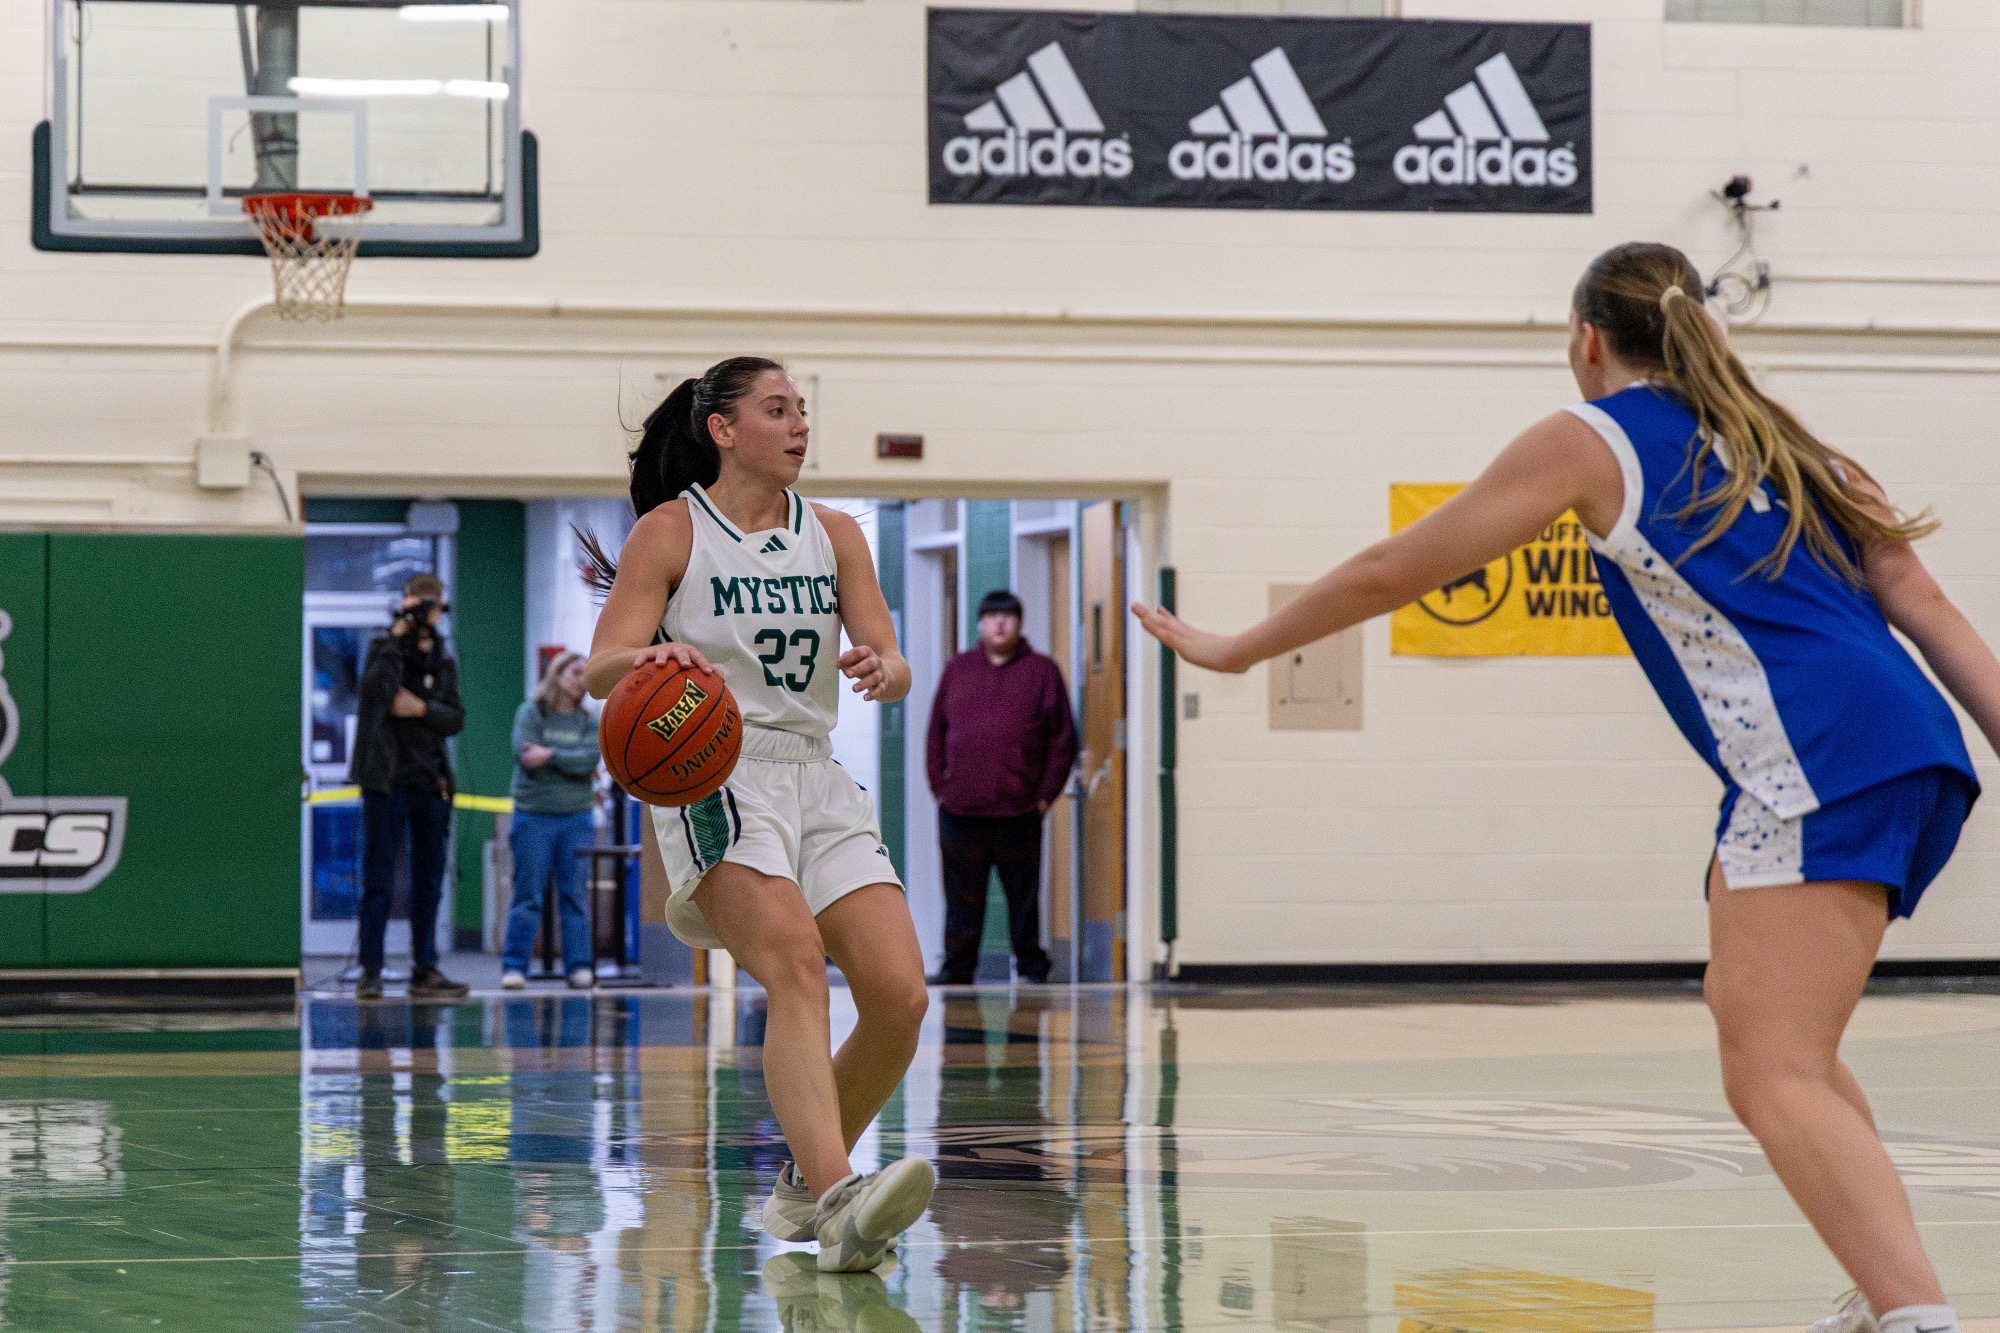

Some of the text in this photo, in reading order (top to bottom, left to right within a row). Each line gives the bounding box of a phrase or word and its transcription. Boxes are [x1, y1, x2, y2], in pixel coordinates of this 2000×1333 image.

[942, 127, 1134, 178] adidas
[1168, 130, 1356, 183] adidas
[1392, 135, 1578, 187] adidas
[1523, 549, 1601, 584] WIL
[1525, 591, 1611, 617] WING
[754, 629, 820, 692] 23
[648, 679, 707, 740] NAIA
[671, 703, 738, 782] SPALDING
